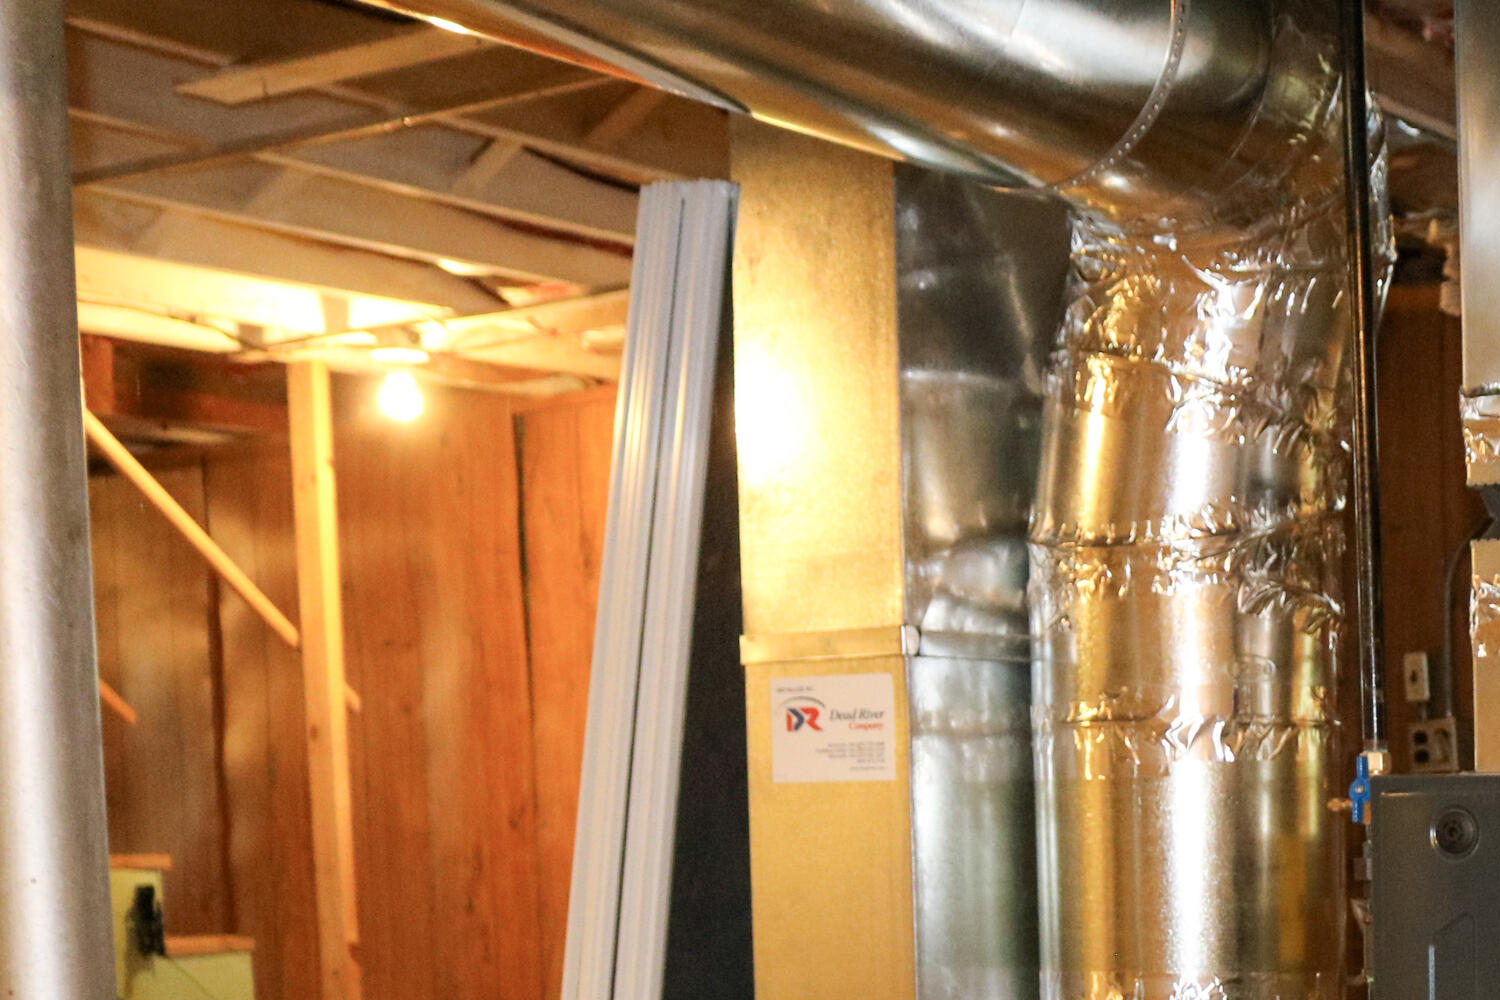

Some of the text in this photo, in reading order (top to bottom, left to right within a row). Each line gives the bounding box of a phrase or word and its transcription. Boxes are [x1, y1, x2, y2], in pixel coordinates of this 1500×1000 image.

[829, 708, 885, 721] Dead River
[849, 722, 885, 732] Company
